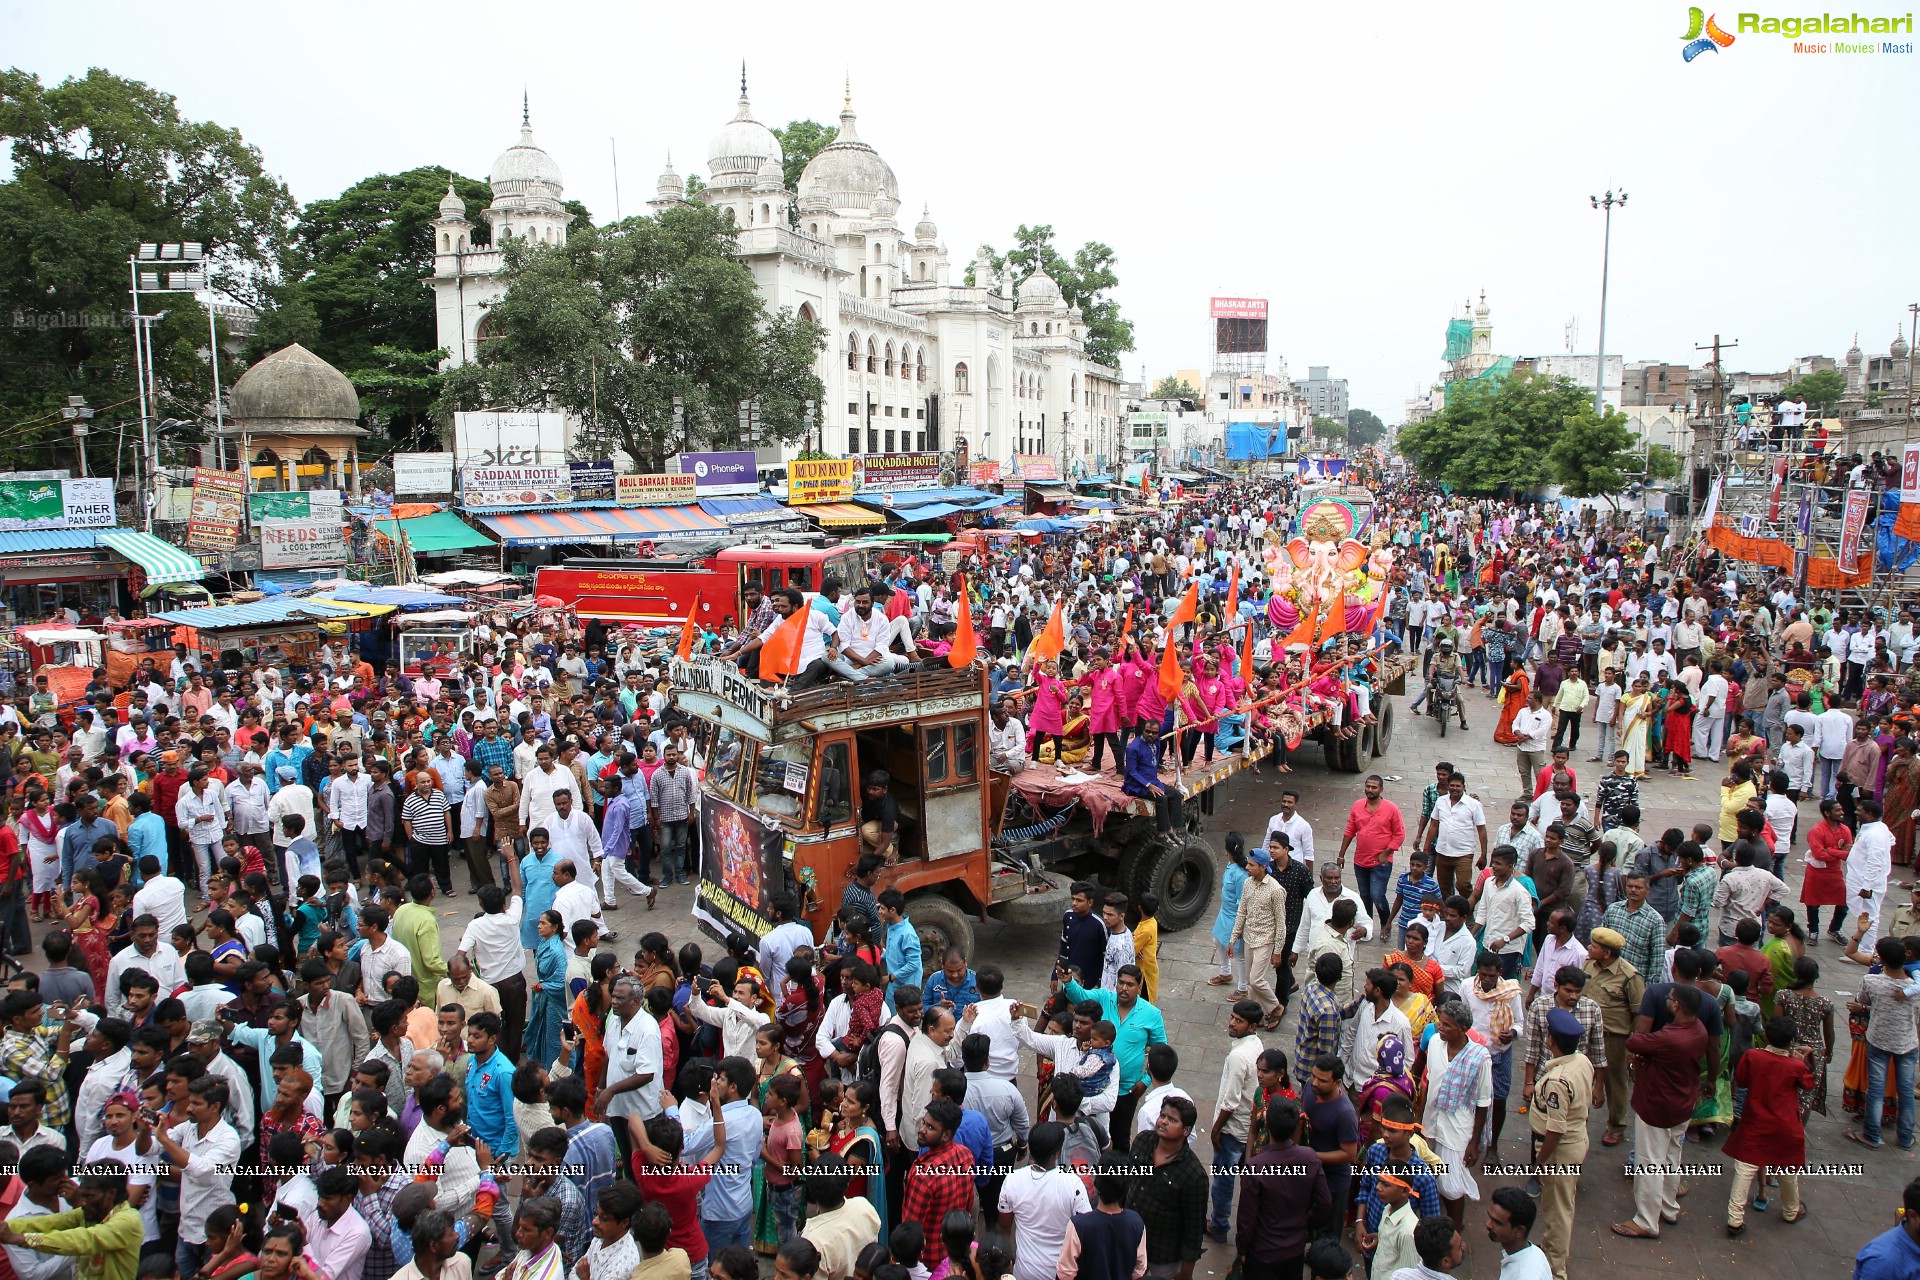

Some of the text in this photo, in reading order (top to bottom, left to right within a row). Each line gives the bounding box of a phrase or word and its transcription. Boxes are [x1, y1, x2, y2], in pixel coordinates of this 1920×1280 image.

[1214, 300, 1264, 309] BHASKAR ARTS
[865, 456, 939, 470] MUQADDAR HOTEL
[711, 464, 745, 473] PhonePe
[795, 463, 849, 478] MUNNU
[474, 470, 521, 480] SADDAM
[524, 468, 560, 479] HOTEL
[619, 478, 637, 488] ABUL
[639, 477, 669, 487] BARKAAT
[671, 476, 695, 486] BAKERY
[803, 479, 840, 489] PAN SHOP
[67, 504, 111, 514] TAHER
[68, 515, 112, 525] PAN SHOP
[265, 527, 317, 544] NEEDS
[201, 555, 219, 565] HOTEL
[182, 599, 208, 607] Minute
[723, 674, 765, 720] PERMIT
